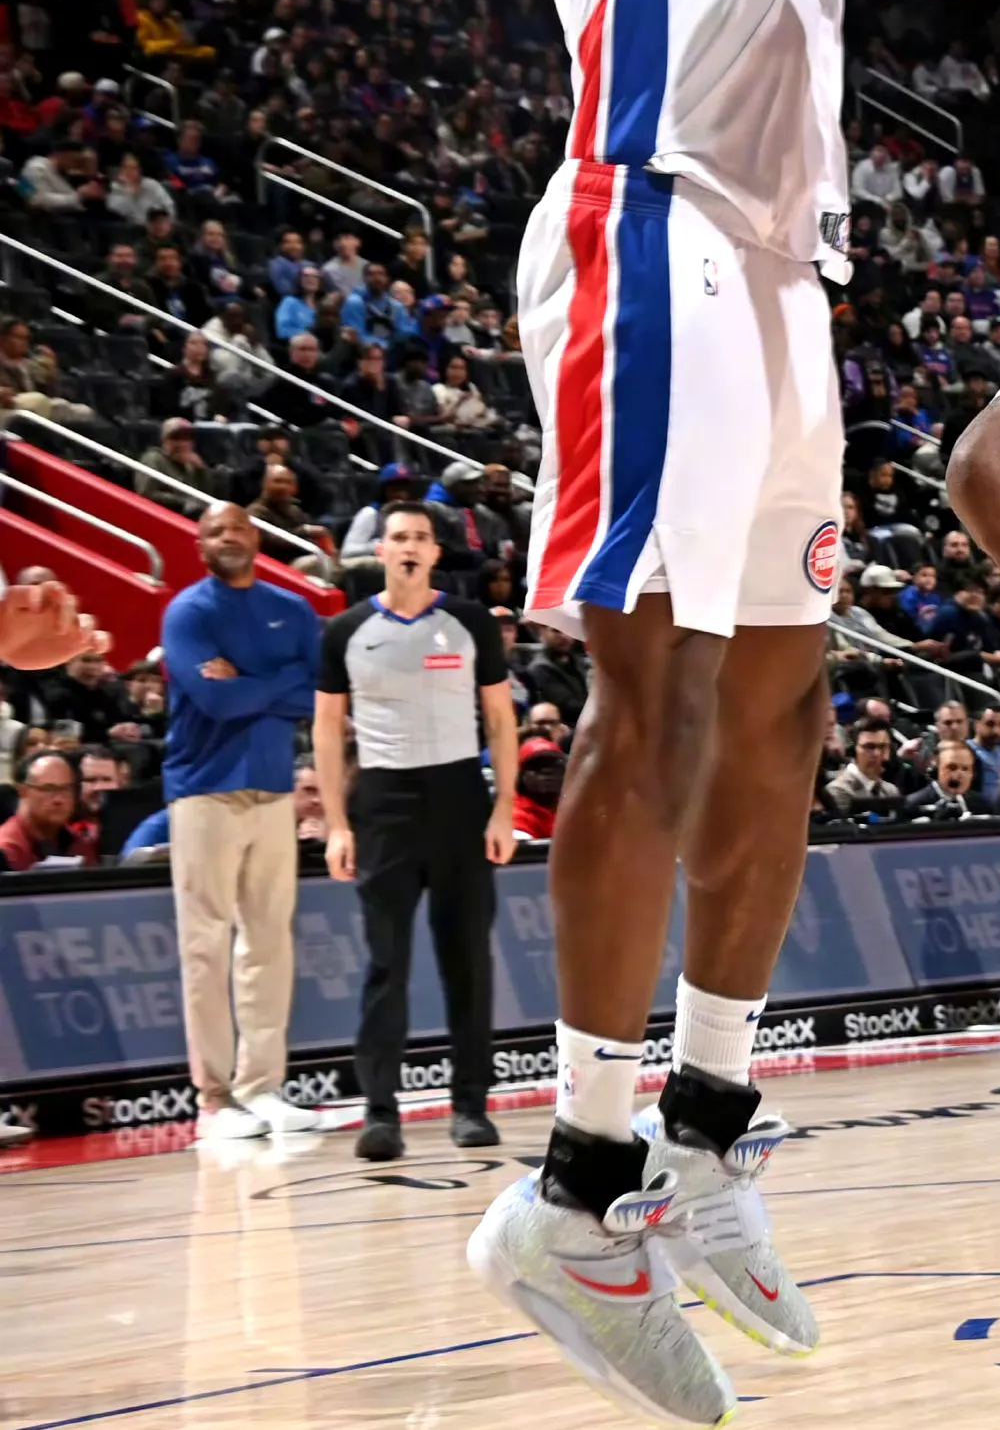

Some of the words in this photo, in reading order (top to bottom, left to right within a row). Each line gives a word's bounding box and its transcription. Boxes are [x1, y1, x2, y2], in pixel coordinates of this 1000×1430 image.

[33, 989, 104, 1038] TO
[83, 1087, 195, 1125] StockX
[844, 1006, 919, 1038] StockX
